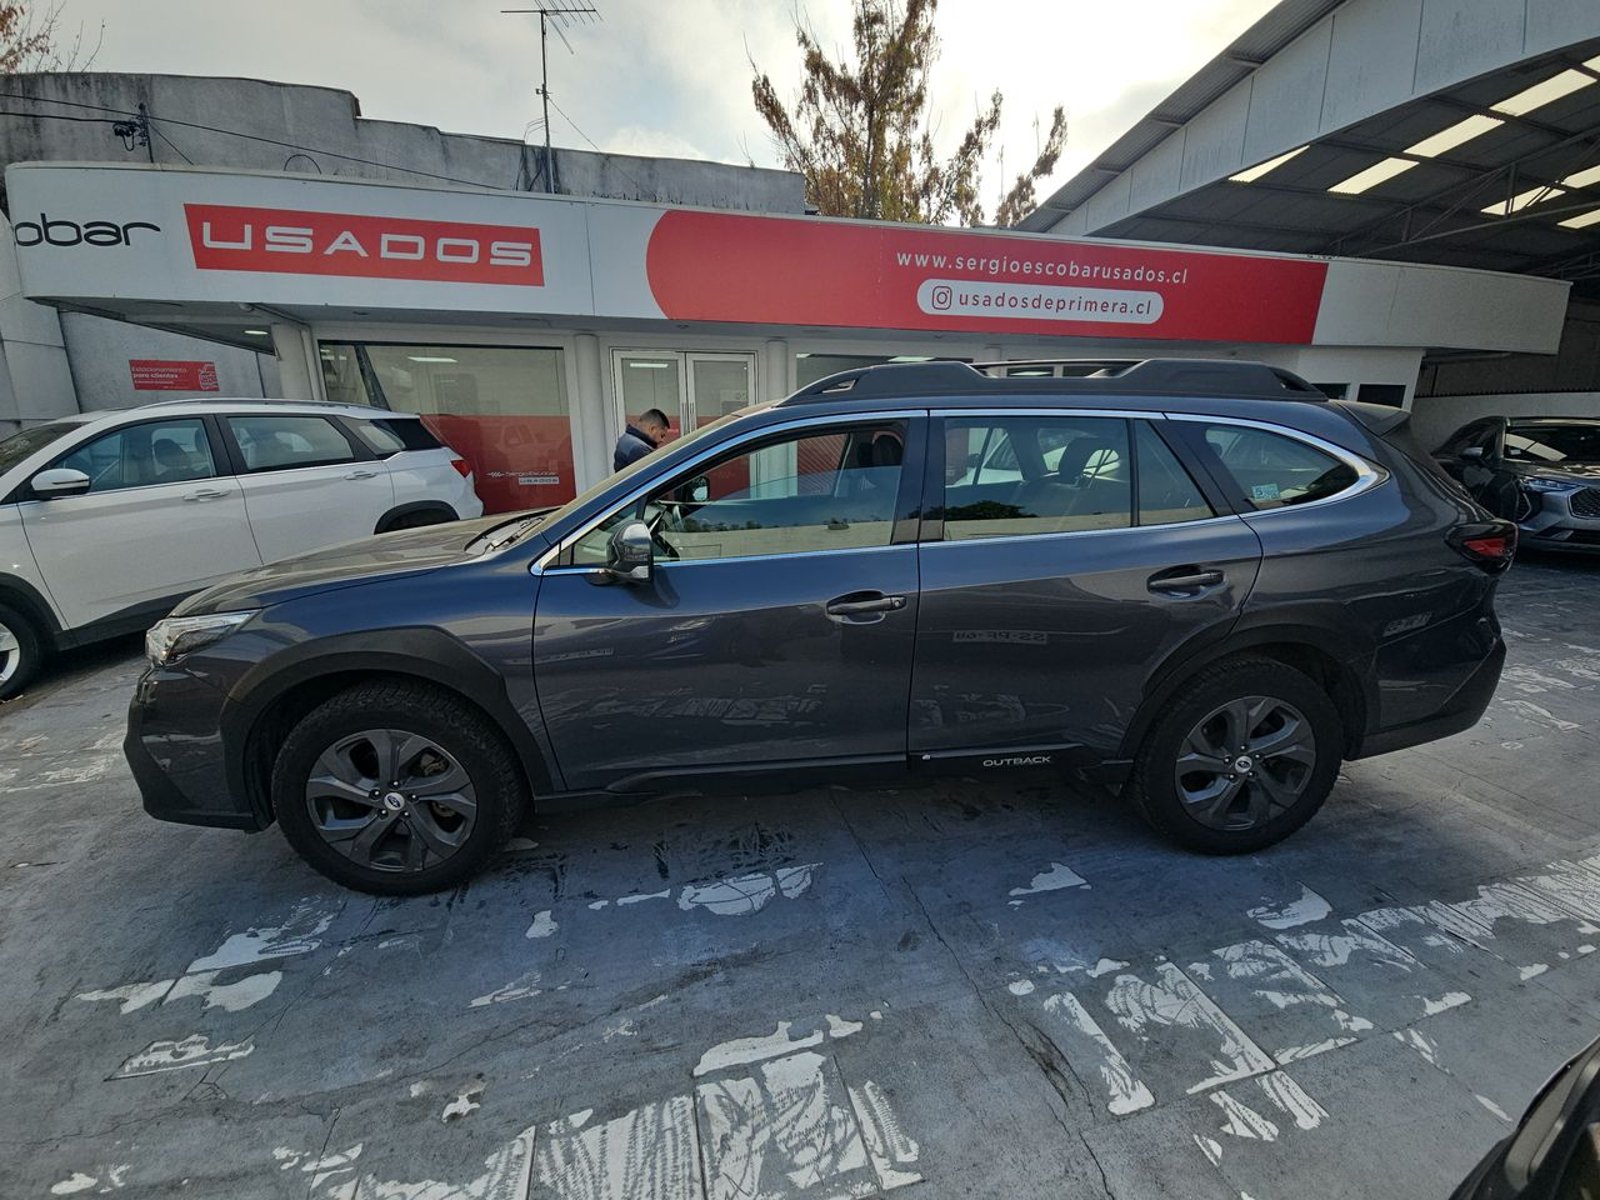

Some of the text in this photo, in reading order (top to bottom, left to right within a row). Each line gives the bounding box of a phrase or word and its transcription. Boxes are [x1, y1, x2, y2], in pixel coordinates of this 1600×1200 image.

[202, 212, 532, 266] USADOS
[897, 252, 1188, 284] www.sergioescobarusados.cl
[959, 291, 1151, 314] usadosdeprimera.cl
[983, 756, 1051, 767] OUTBACK
